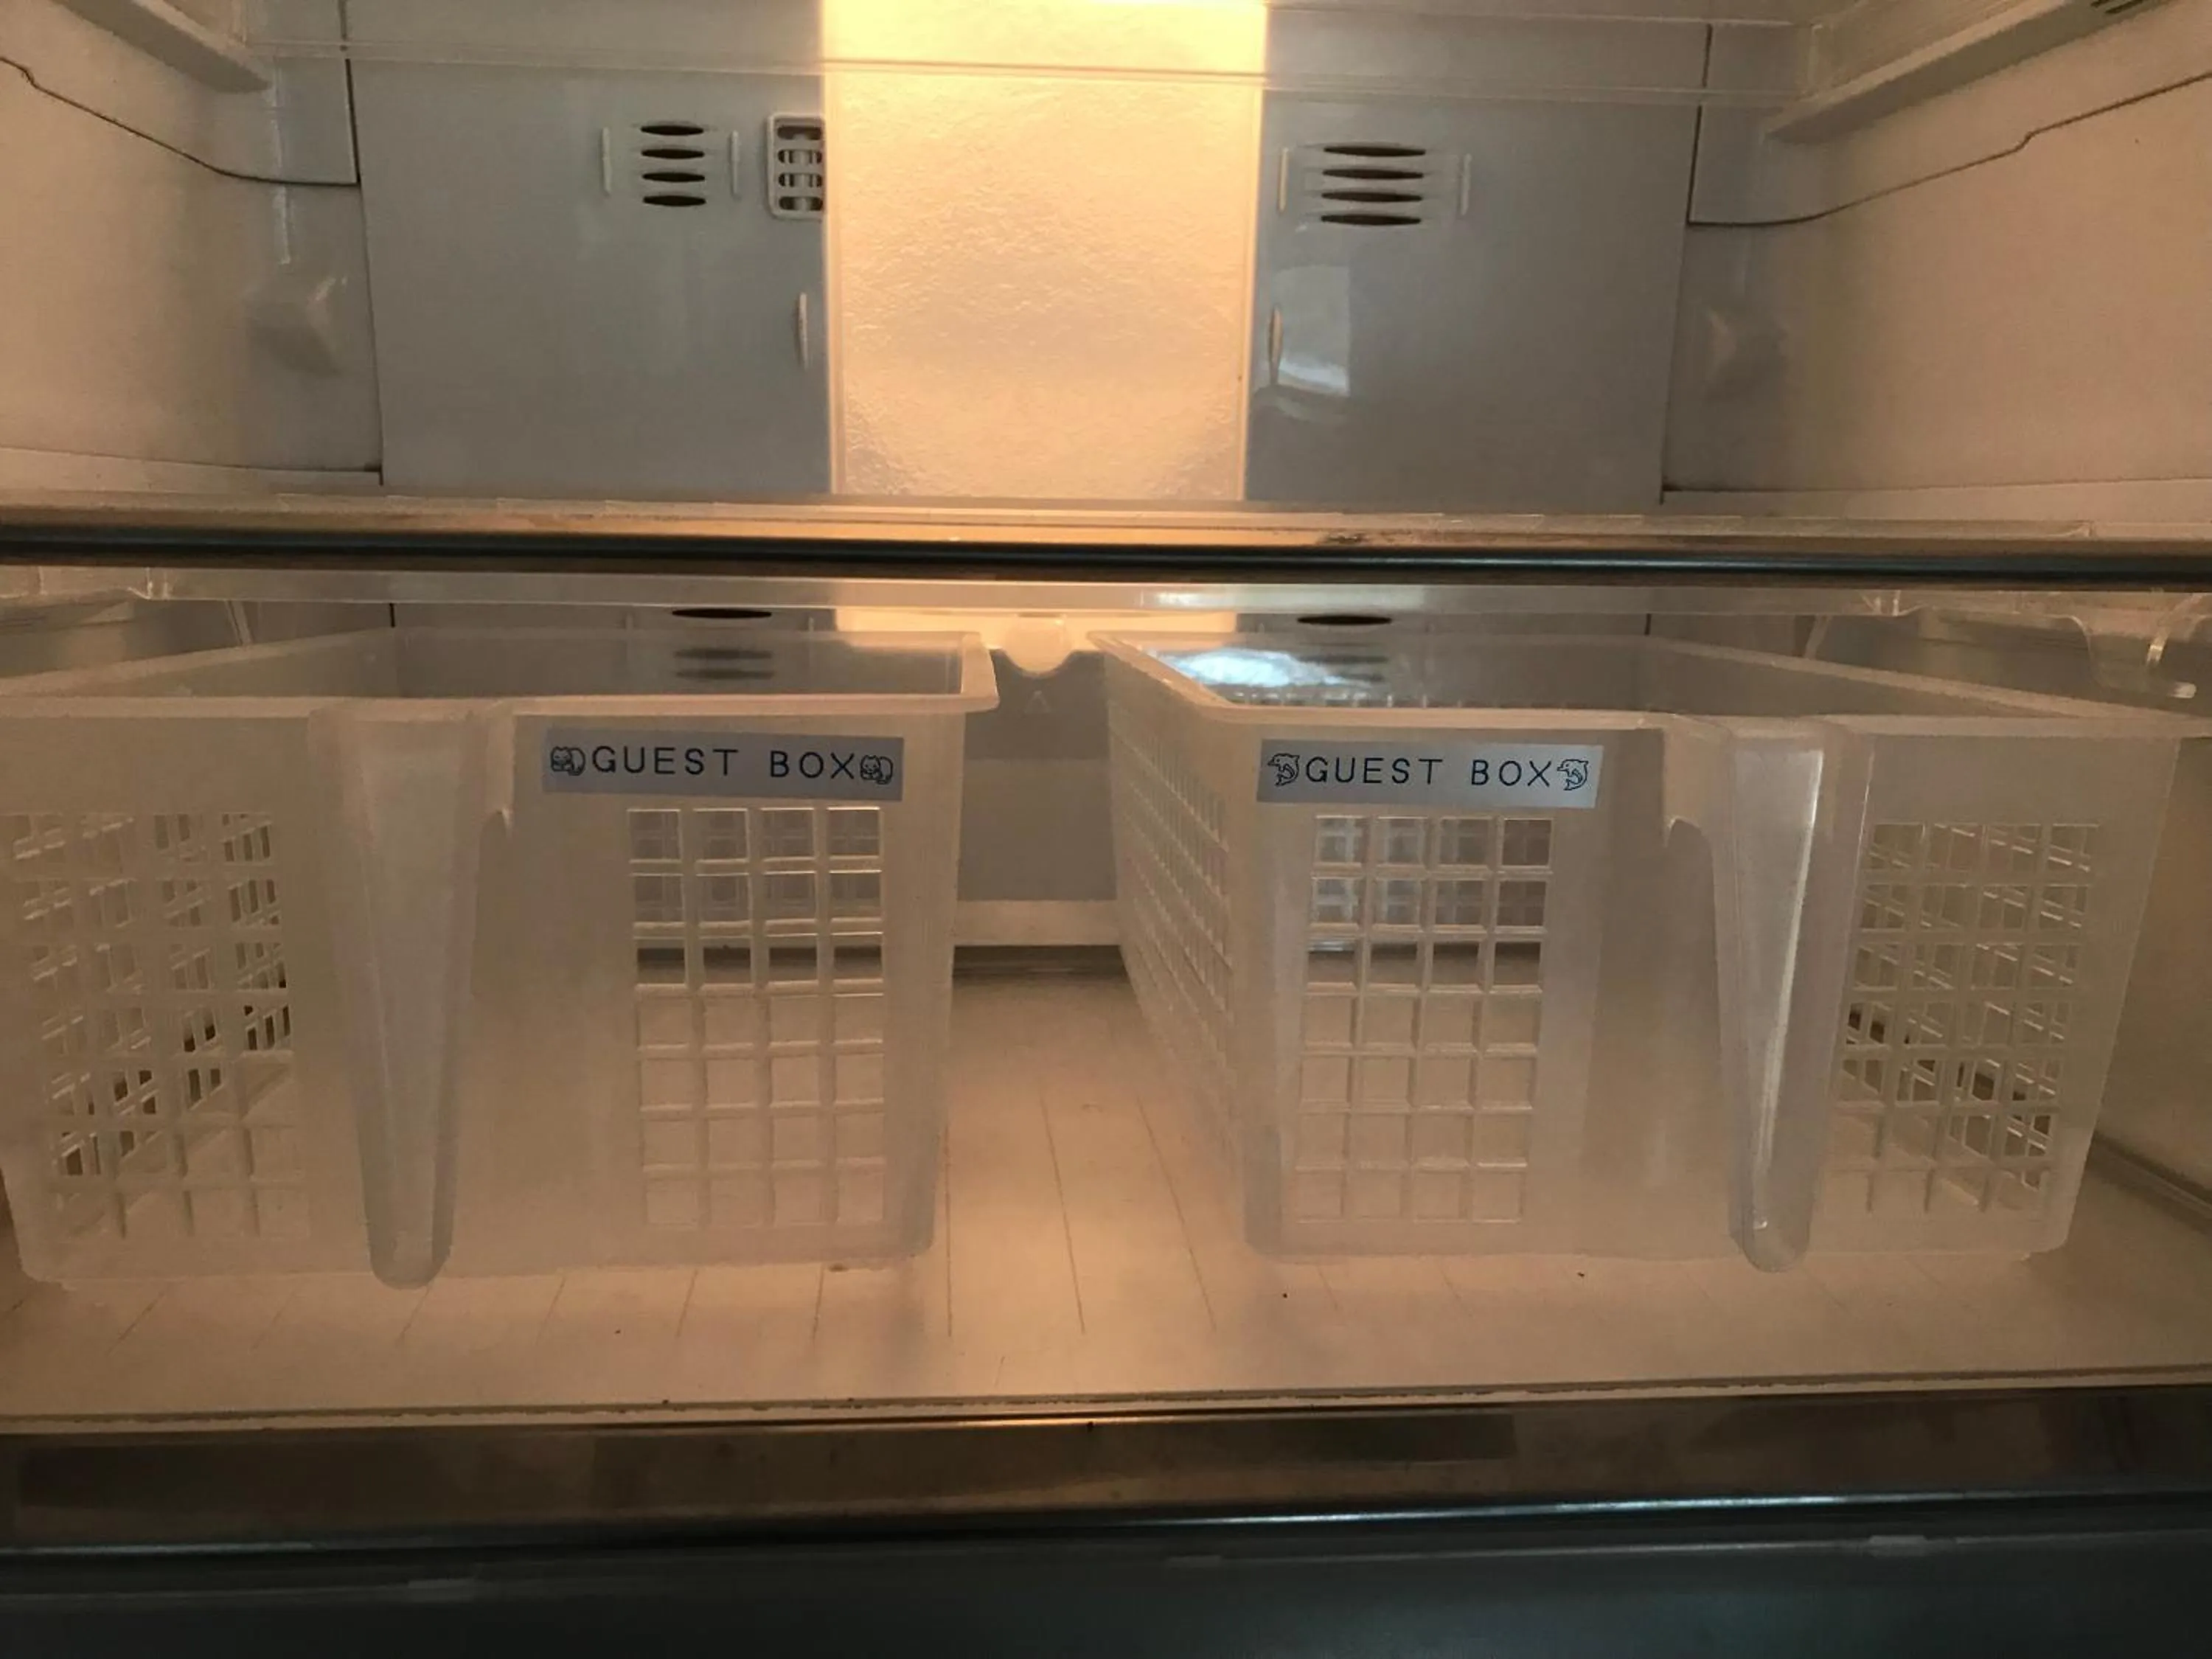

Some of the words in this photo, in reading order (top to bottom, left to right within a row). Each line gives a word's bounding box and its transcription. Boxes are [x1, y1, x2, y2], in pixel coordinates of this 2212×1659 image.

[591, 745, 740, 776] GUEST
[769, 750, 855, 780] BOX
[1305, 756, 1444, 785] GUEST
[1471, 759, 1553, 788] BOX
